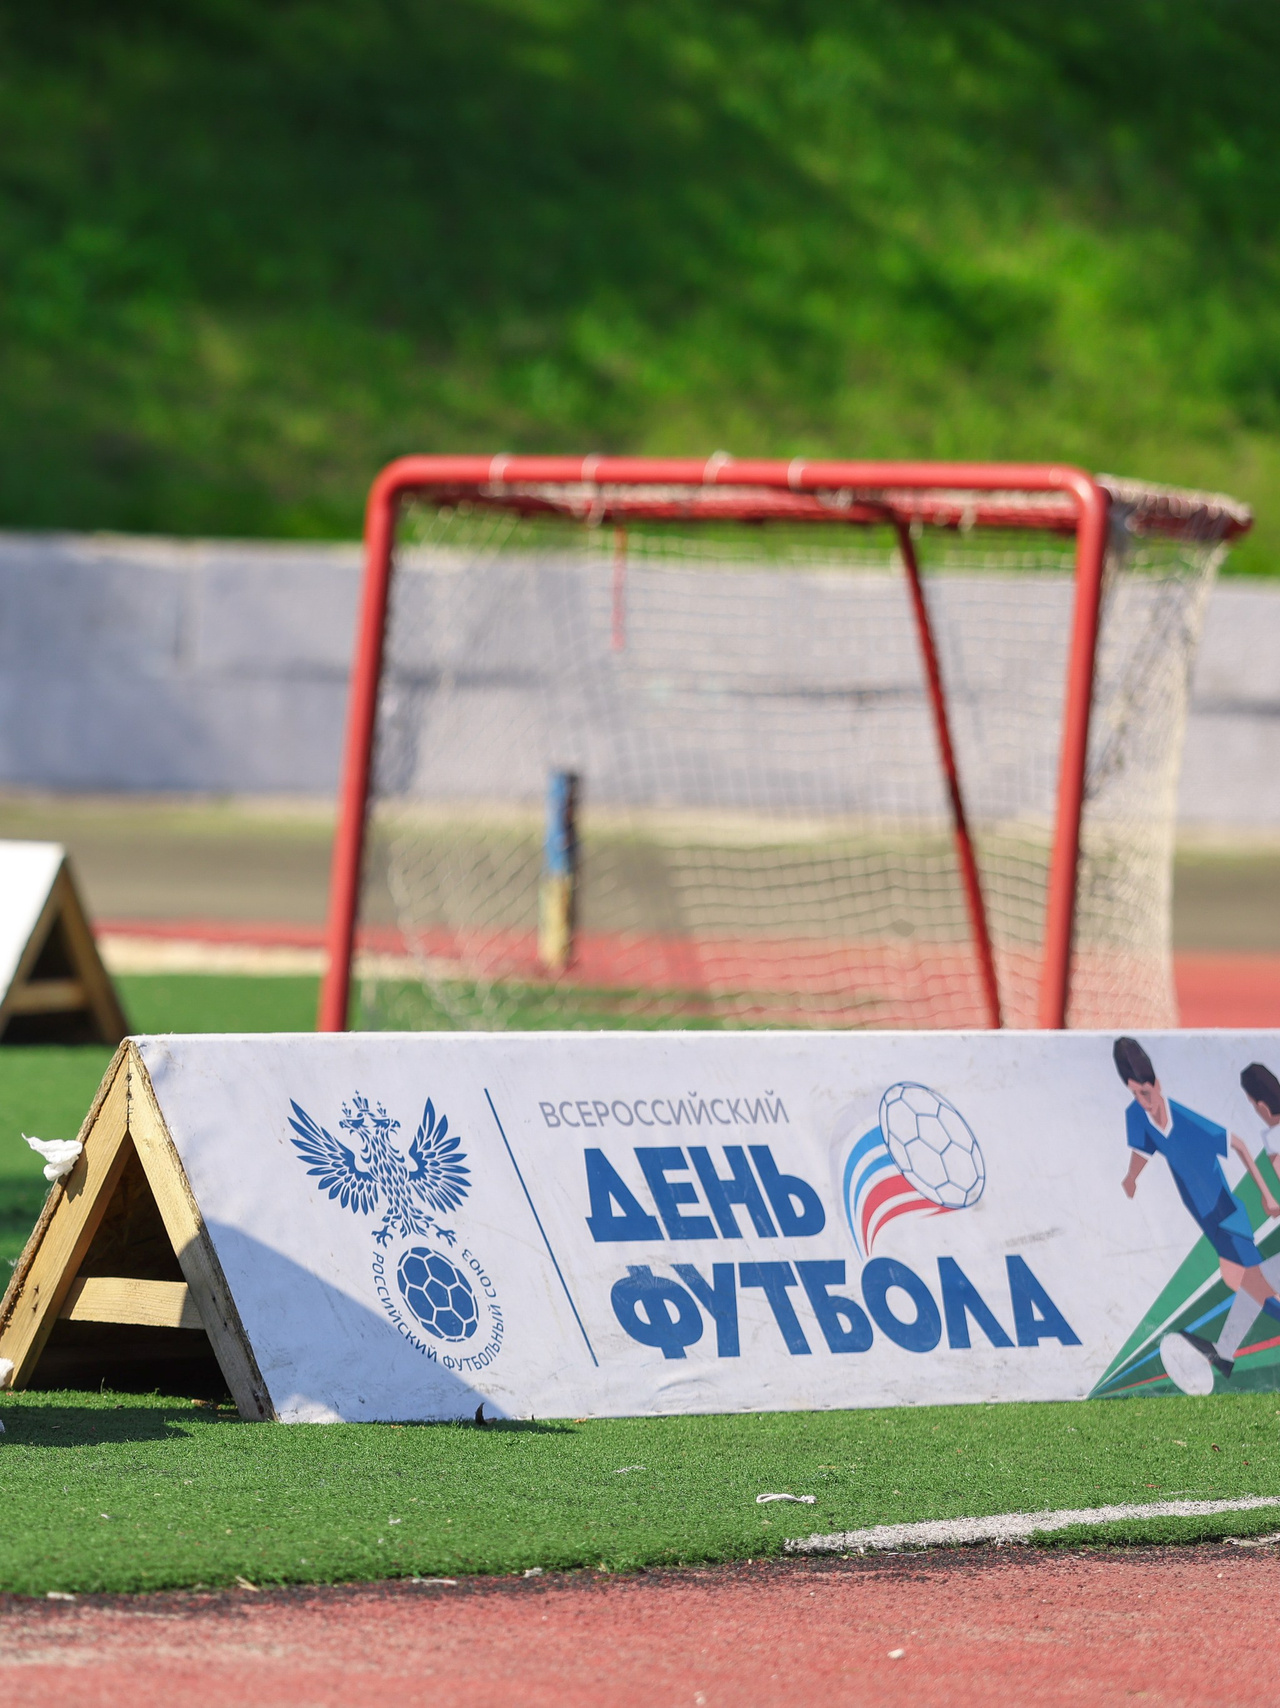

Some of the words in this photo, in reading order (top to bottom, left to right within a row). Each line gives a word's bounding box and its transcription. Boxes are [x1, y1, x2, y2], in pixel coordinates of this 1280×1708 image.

[538, 1090, 790, 1128] ВСЕРОССИЙСКИЙ
[584, 1144, 826, 1243] ДЕНЬ
[372, 1251, 437, 1362] РОССИЙСКИЙ
[461, 1249, 497, 1298] СОЮЗ
[610, 1254, 1083, 1359] ФУТБОЛА
[443, 1304, 504, 1371] ФУТБОЛЬНЫЙ
